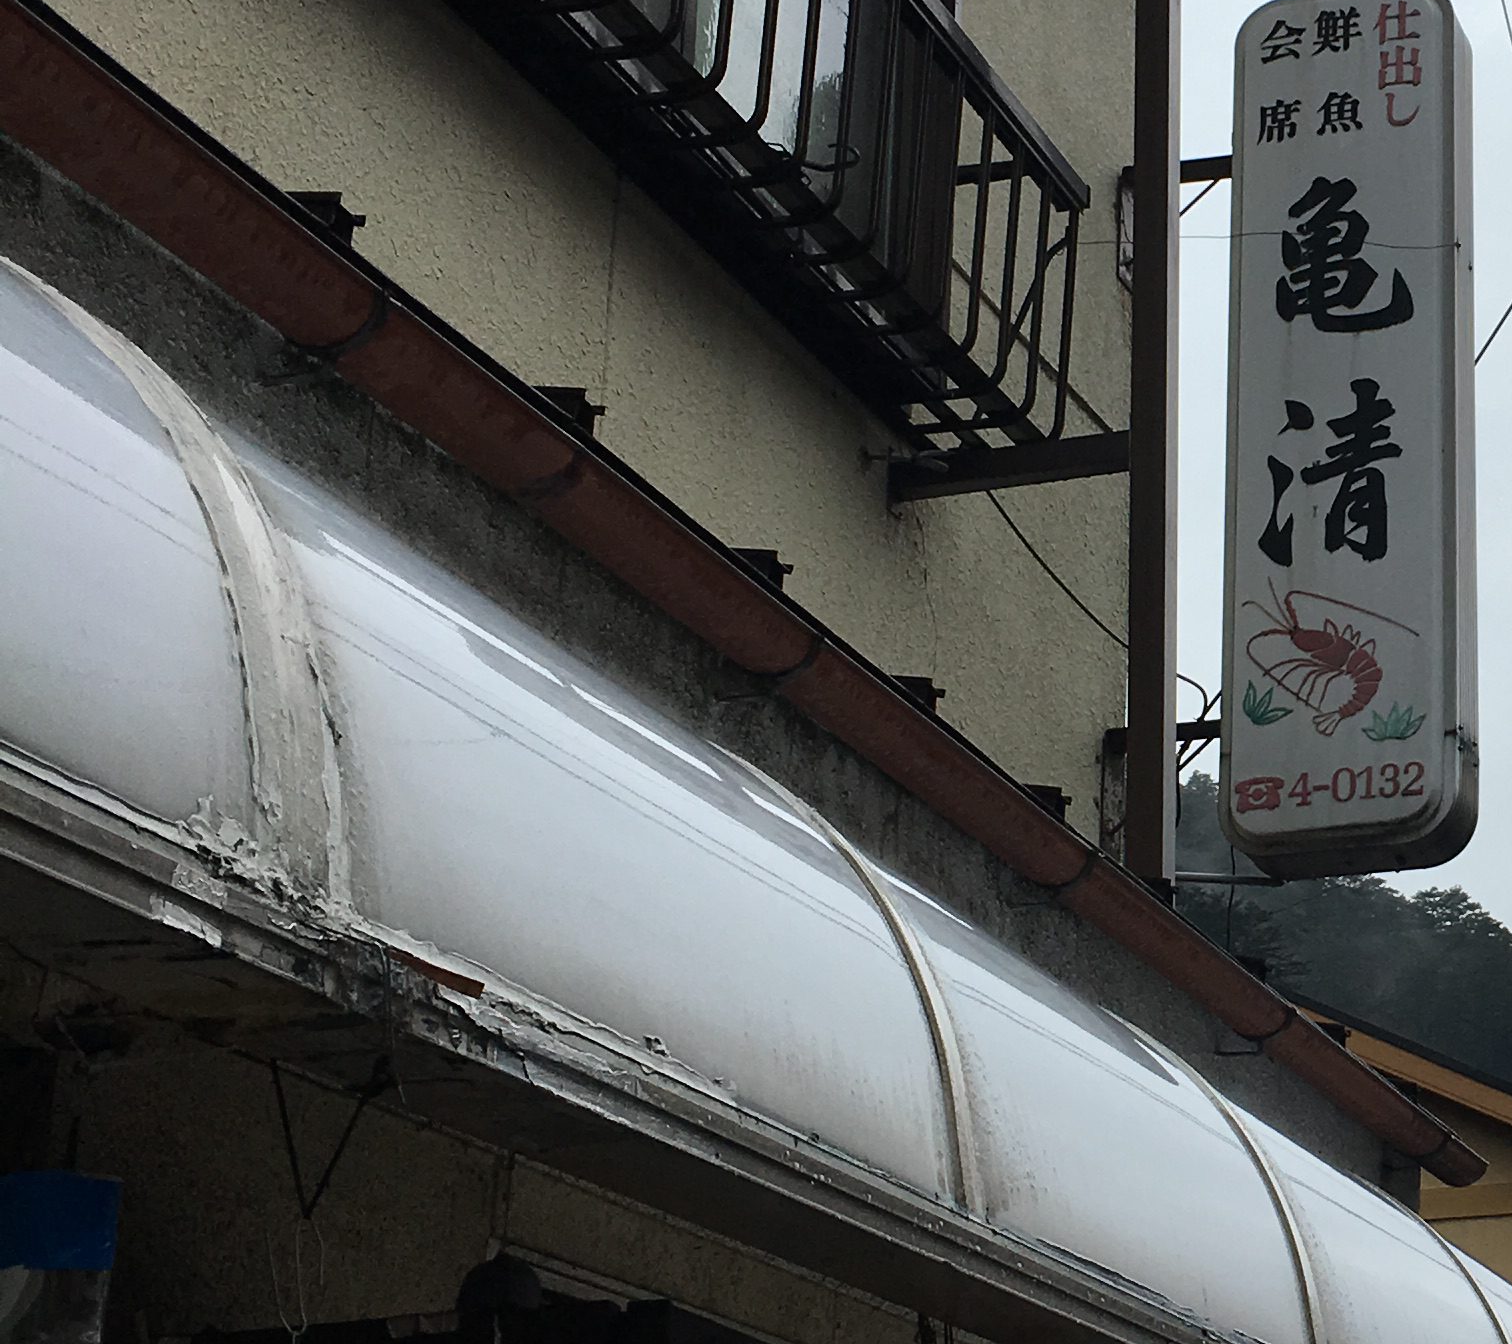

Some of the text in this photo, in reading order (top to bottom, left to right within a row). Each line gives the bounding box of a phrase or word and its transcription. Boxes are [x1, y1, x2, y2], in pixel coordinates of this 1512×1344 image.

[1257, 20, 1306, 145] 会席
[1312, 5, 1364, 136] 鮮魚
[1373, 0, 1422, 128] 仕出し
[1257, 175, 1415, 568] 亀清
[1288, 761, 1425, 808] 4-0132
